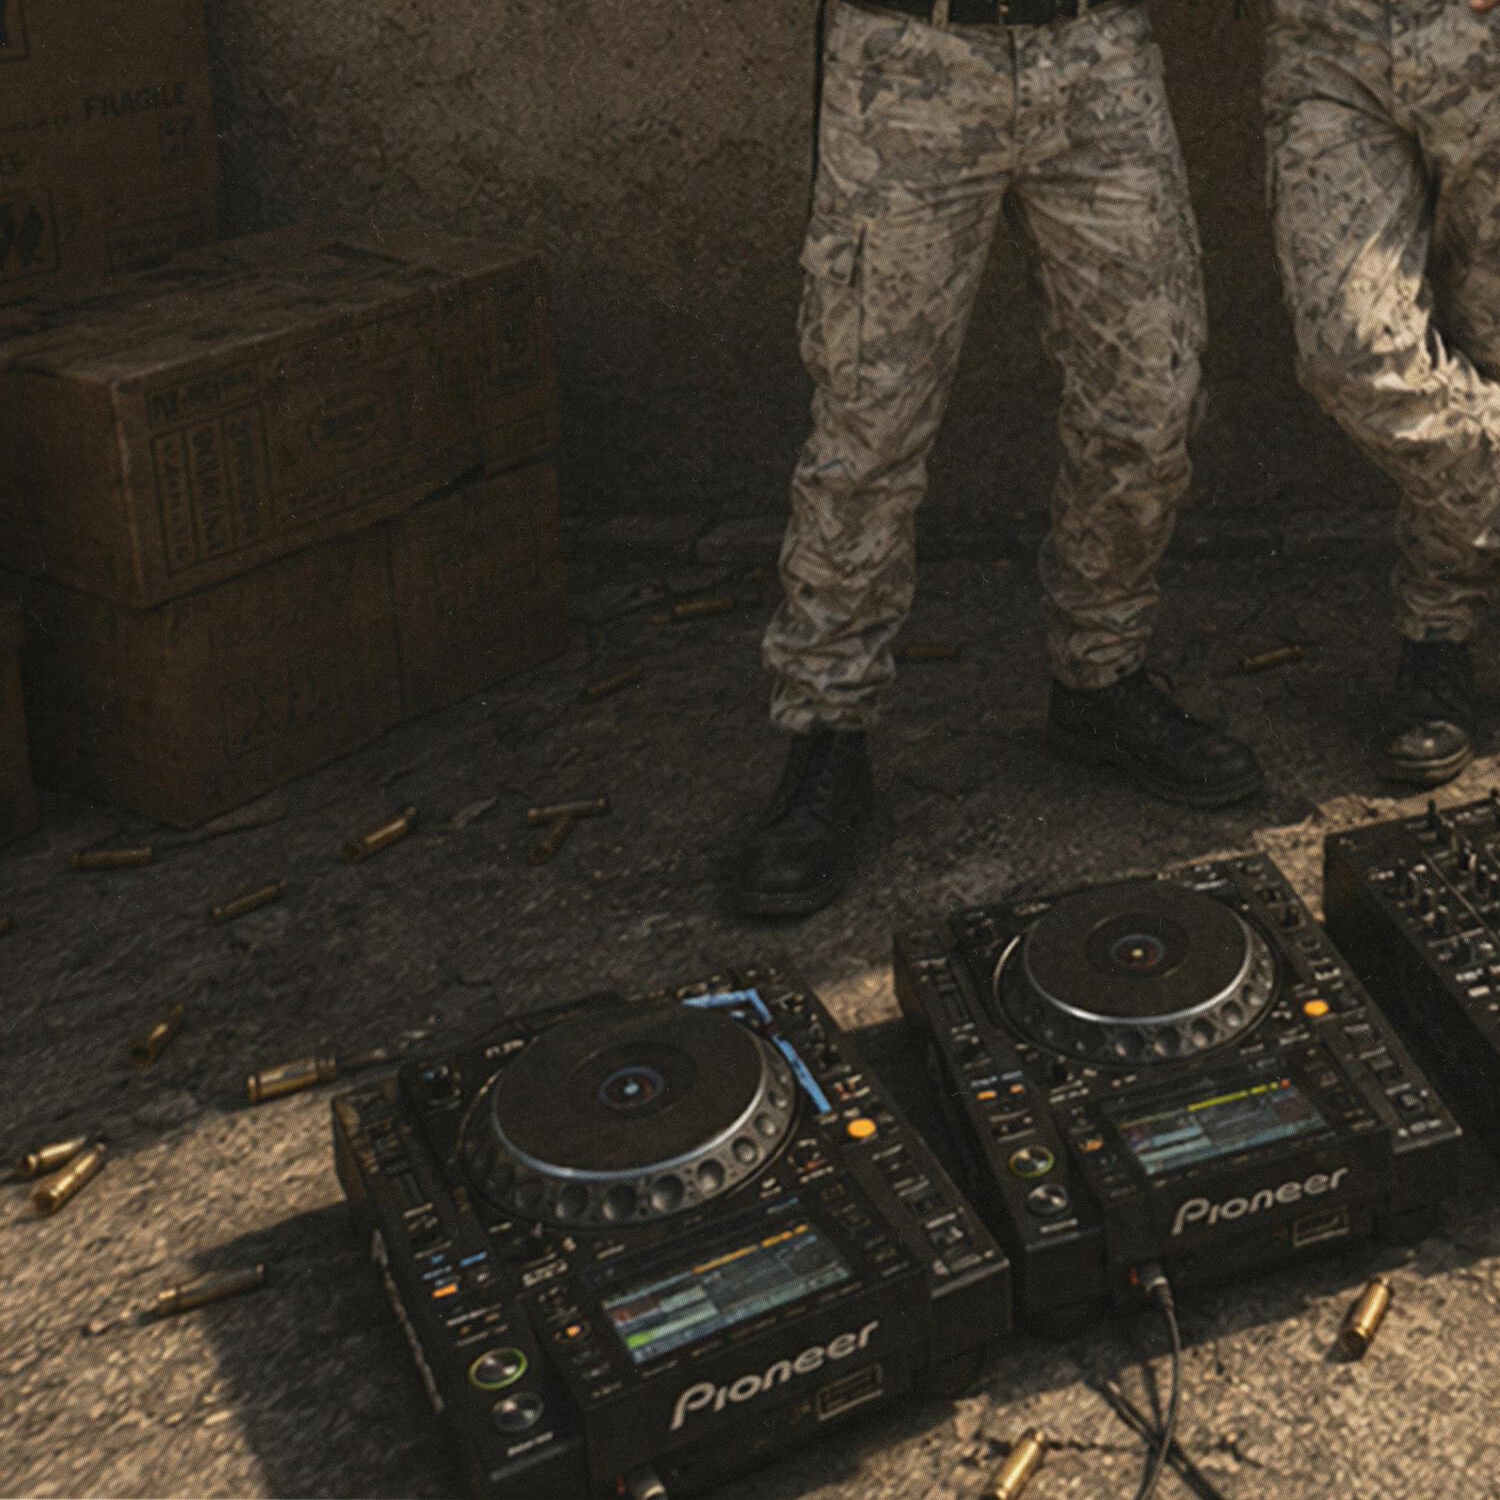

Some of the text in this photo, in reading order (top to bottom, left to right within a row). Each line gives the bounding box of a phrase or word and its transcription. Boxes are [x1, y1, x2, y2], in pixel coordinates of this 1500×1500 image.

[83, 81, 188, 120] FRAGILE
[1169, 1166, 1350, 1238] Pioneer
[669, 1318, 881, 1432] Pioneer
